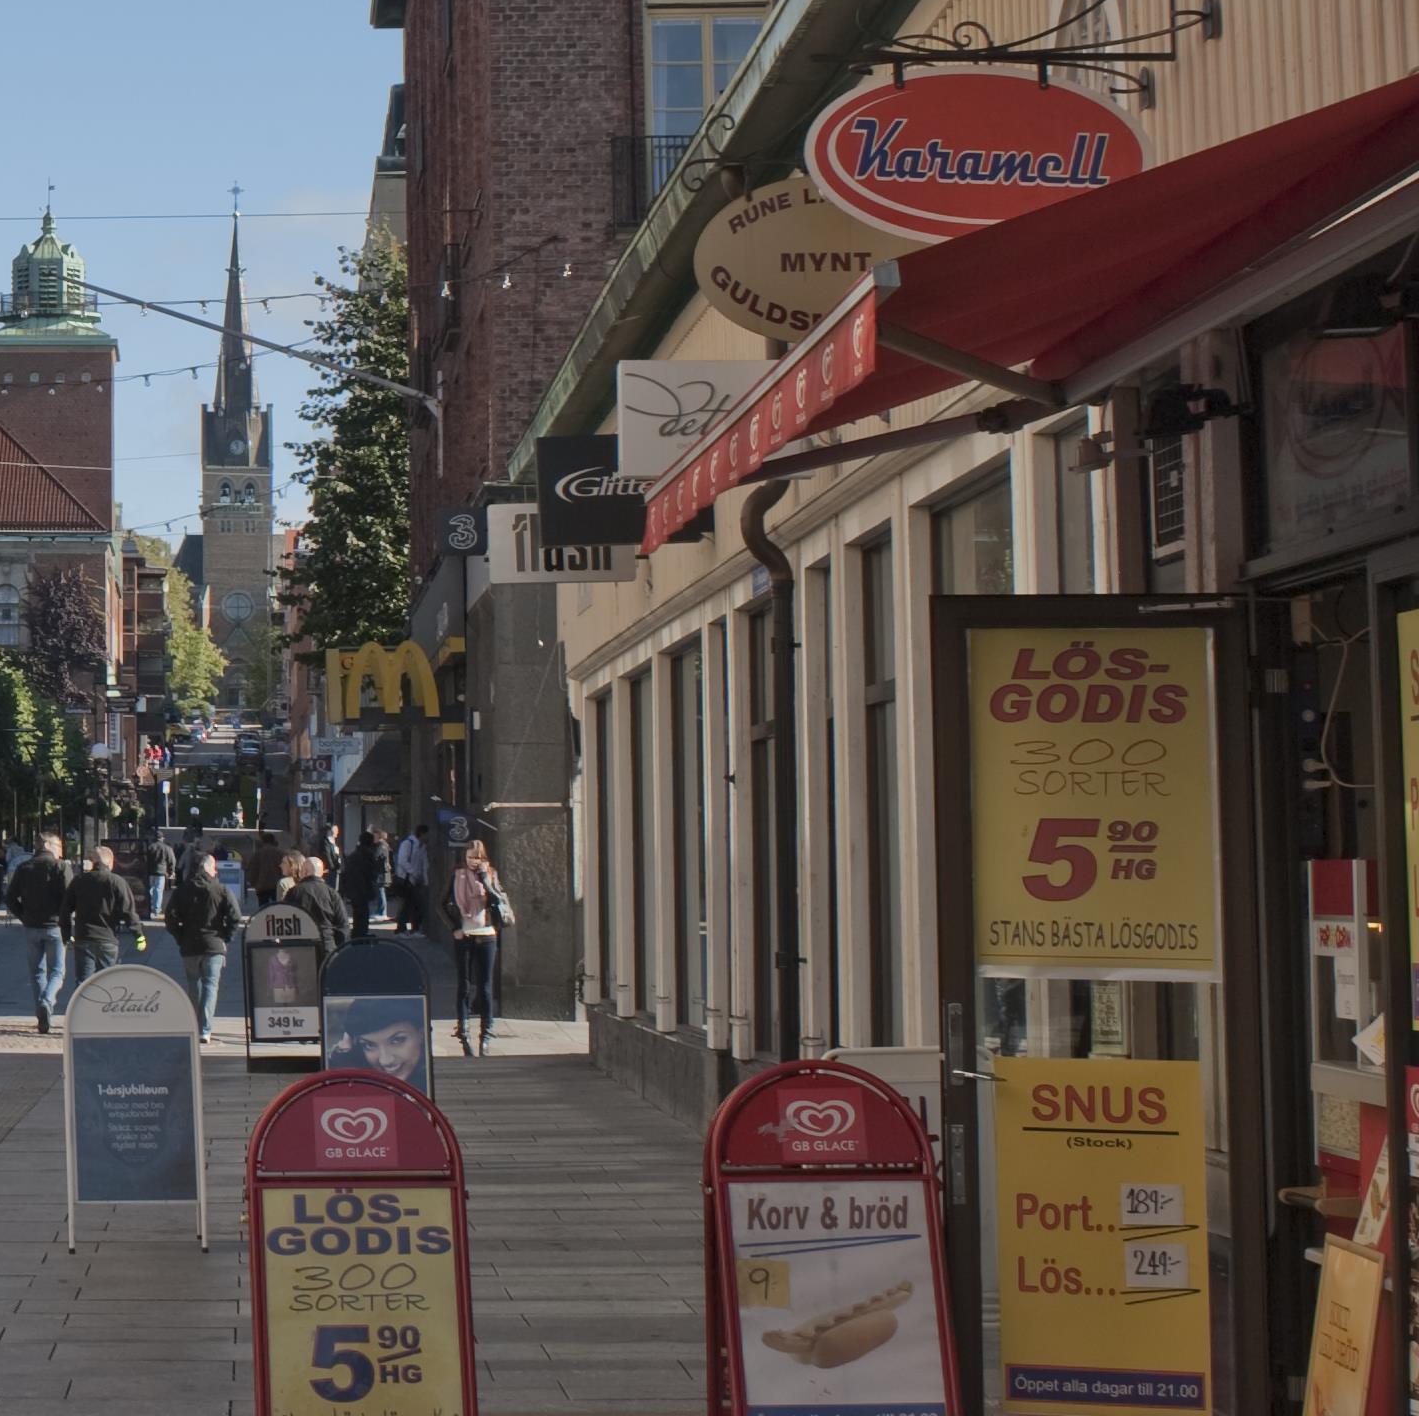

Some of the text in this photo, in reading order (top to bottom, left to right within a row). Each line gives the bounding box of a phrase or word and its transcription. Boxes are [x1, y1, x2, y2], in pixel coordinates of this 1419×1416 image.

[850, 117, 1111, 189] Karamell
[728, 192, 792, 234] RUNE
[780, 252, 872, 273] MYNT
[711, 265, 823, 332] GULDS
[568, 472, 656, 497] Glitte
[1010, 641, 1170, 681] LÖS-
[989, 683, 1189, 724] GODIS
[1010, 738, 1167, 766] 300
[1013, 770, 1171, 797] SORTER
[1021, 818, 1159, 902] 5 90
[1110, 859, 1158, 881] HG
[266, 914, 301, 936] flash
[989, 916, 1199, 951] STANS BÄSTA LÖSGODIS
[267, 1016, 305, 1028] 349 kr
[1031, 1084, 1167, 1125] SNUS
[325, 1147, 387, 1159] GB GLACE
[792, 1140, 856, 1152] GB GLACE
[1066, 1136, 1133, 1150] (Stock)
[293, 1187, 420, 1224] LÖS-
[747, 1195, 908, 1230] Korv & bröd
[266, 1226, 453, 1256] GODIS
[292, 1262, 417, 1292] 300
[289, 1292, 430, 1312] SORTER
[309, 1324, 421, 1403] 5 90
[378, 1364, 423, 1384] HG
[1014, 1374, 1199, 1398] Öppet alla dagar till 21.00
